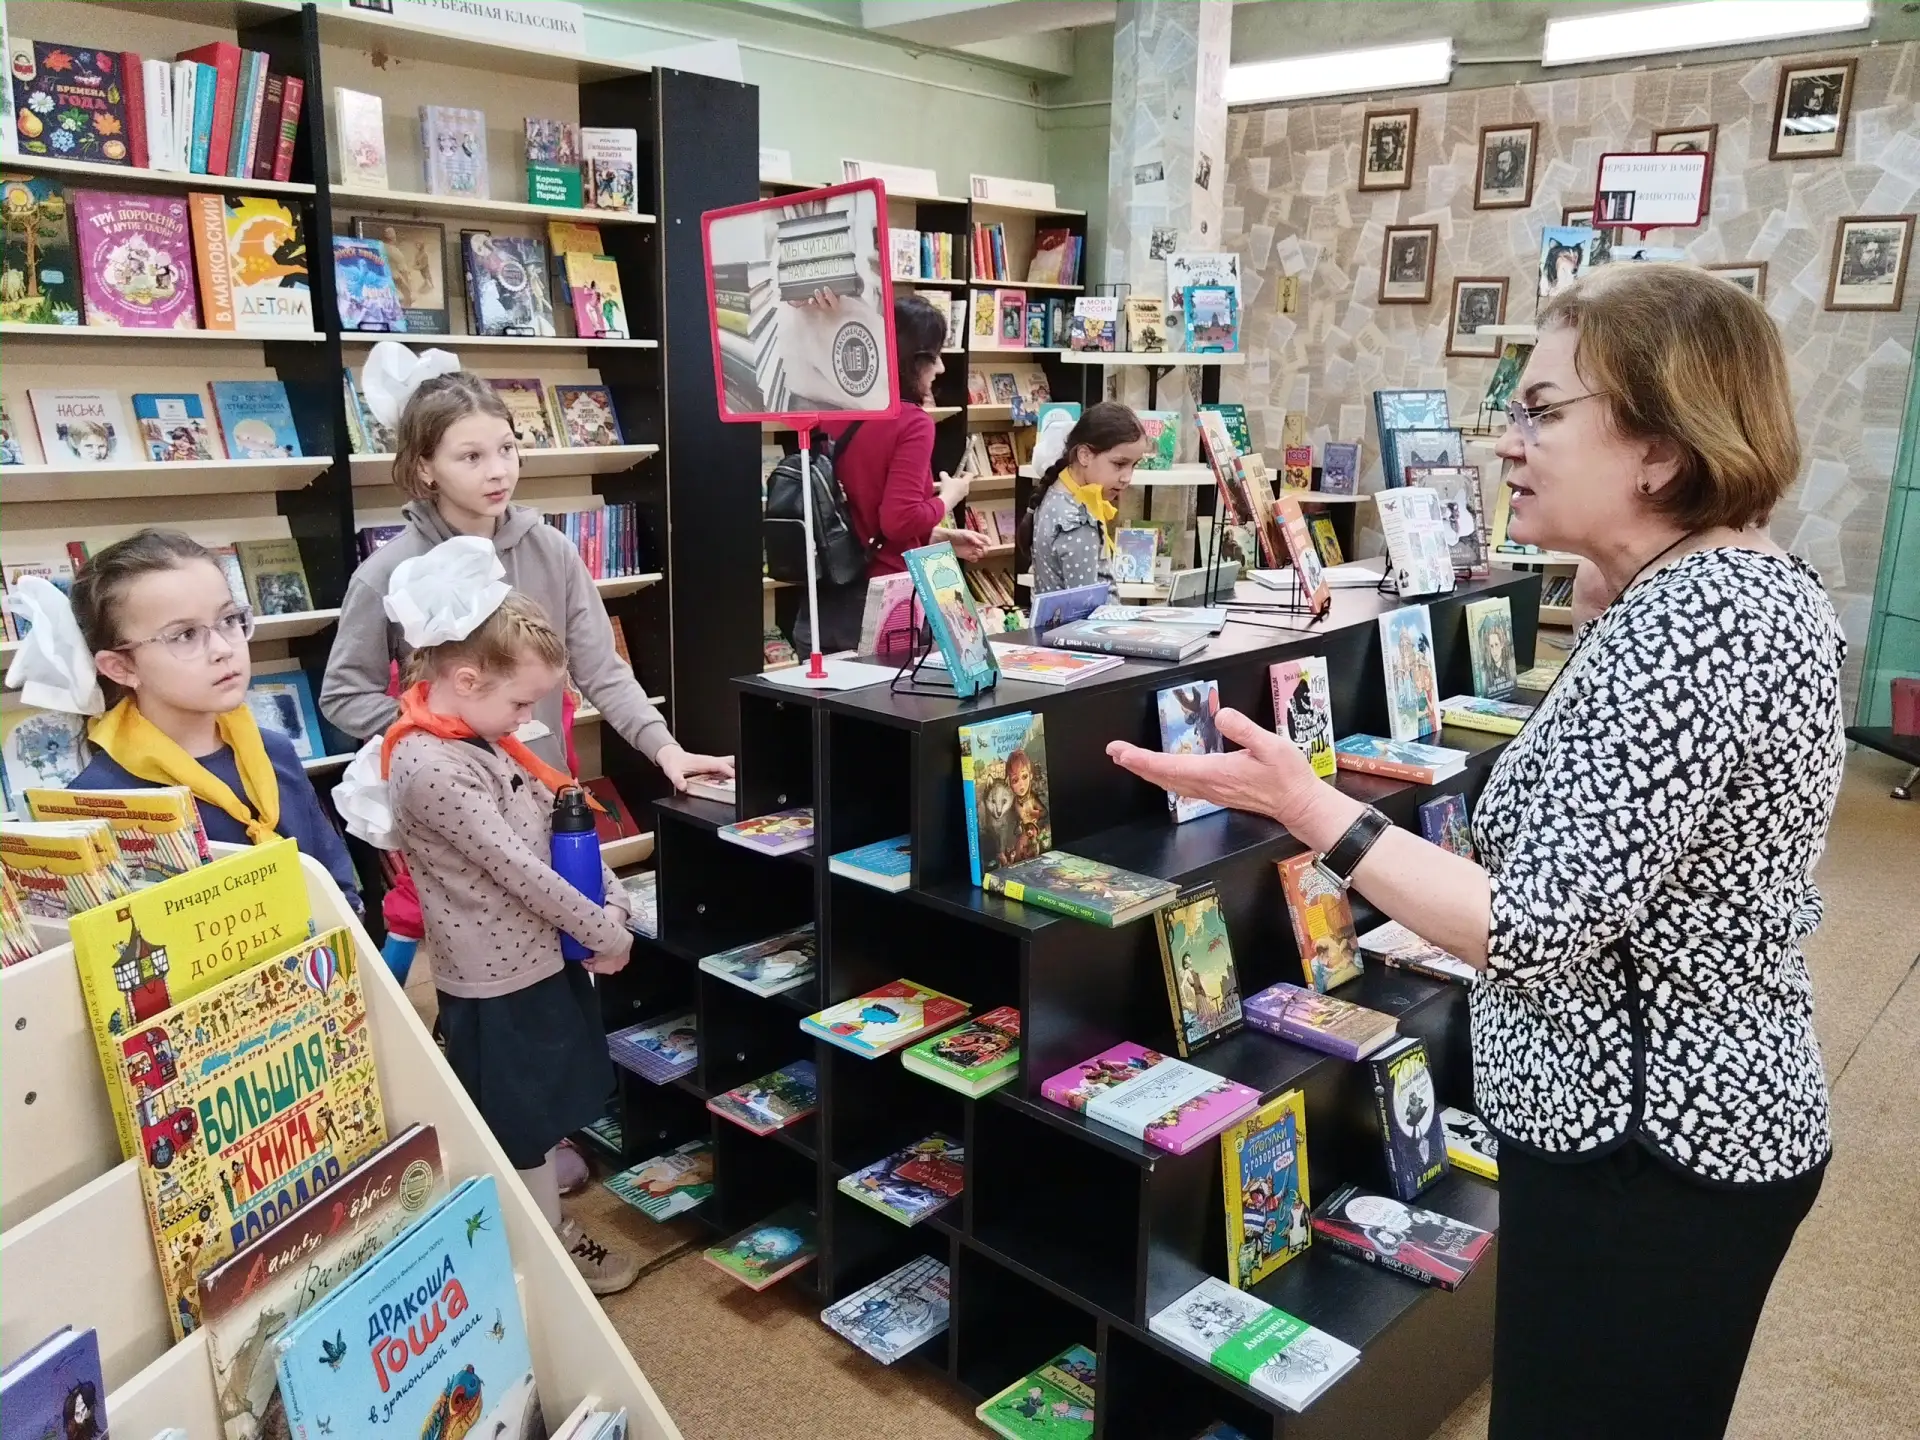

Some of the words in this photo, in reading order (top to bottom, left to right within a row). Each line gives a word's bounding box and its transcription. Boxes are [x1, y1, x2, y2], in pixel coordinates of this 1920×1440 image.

[504, 9, 577, 34] КЛАССИКА
[58, 94, 108, 110] ГОДА
[1632, 163, 1667, 172] КНИГУ
[1679, 163, 1703, 172] МИР
[1636, 192, 1698, 201] ЖИВОТНЫХ
[89, 211, 117, 228] ТРИ
[203, 197, 231, 306] МАЯКОВСКИЙ
[783, 242, 800, 259] МЫ
[788, 264, 807, 280] НАМ
[241, 296, 308, 316] ДЕТЯМ
[835, 327, 874, 356] РЕКОМЕНДУЕМ
[841, 363, 876, 392] ПРОЧТЕНИЮ
[57, 403, 104, 417] НАСЬКА
[164, 883, 221, 916] Ричард
[223, 862, 278, 892] Скарри
[194, 901, 267, 943] Город
[190, 923, 283, 981] добрых
[322, 1017, 337, 1035] 18
[198, 1031, 329, 1156] БОЛЬШАЯ
[242, 1110, 318, 1196] КНИГА
[1249, 1126, 1289, 1155] ПРОГУЛКИ
[368, 1253, 455, 1346] ДРАКОША
[371, 1277, 469, 1393] Гоша
[1243, 1317, 1288, 1351] Амазонка
[1275, 1324, 1300, 1342] Риш
[368, 1407, 379, 1424] в
[382, 1343, 448, 1423] драконской
[450, 1312, 483, 1349] школе
